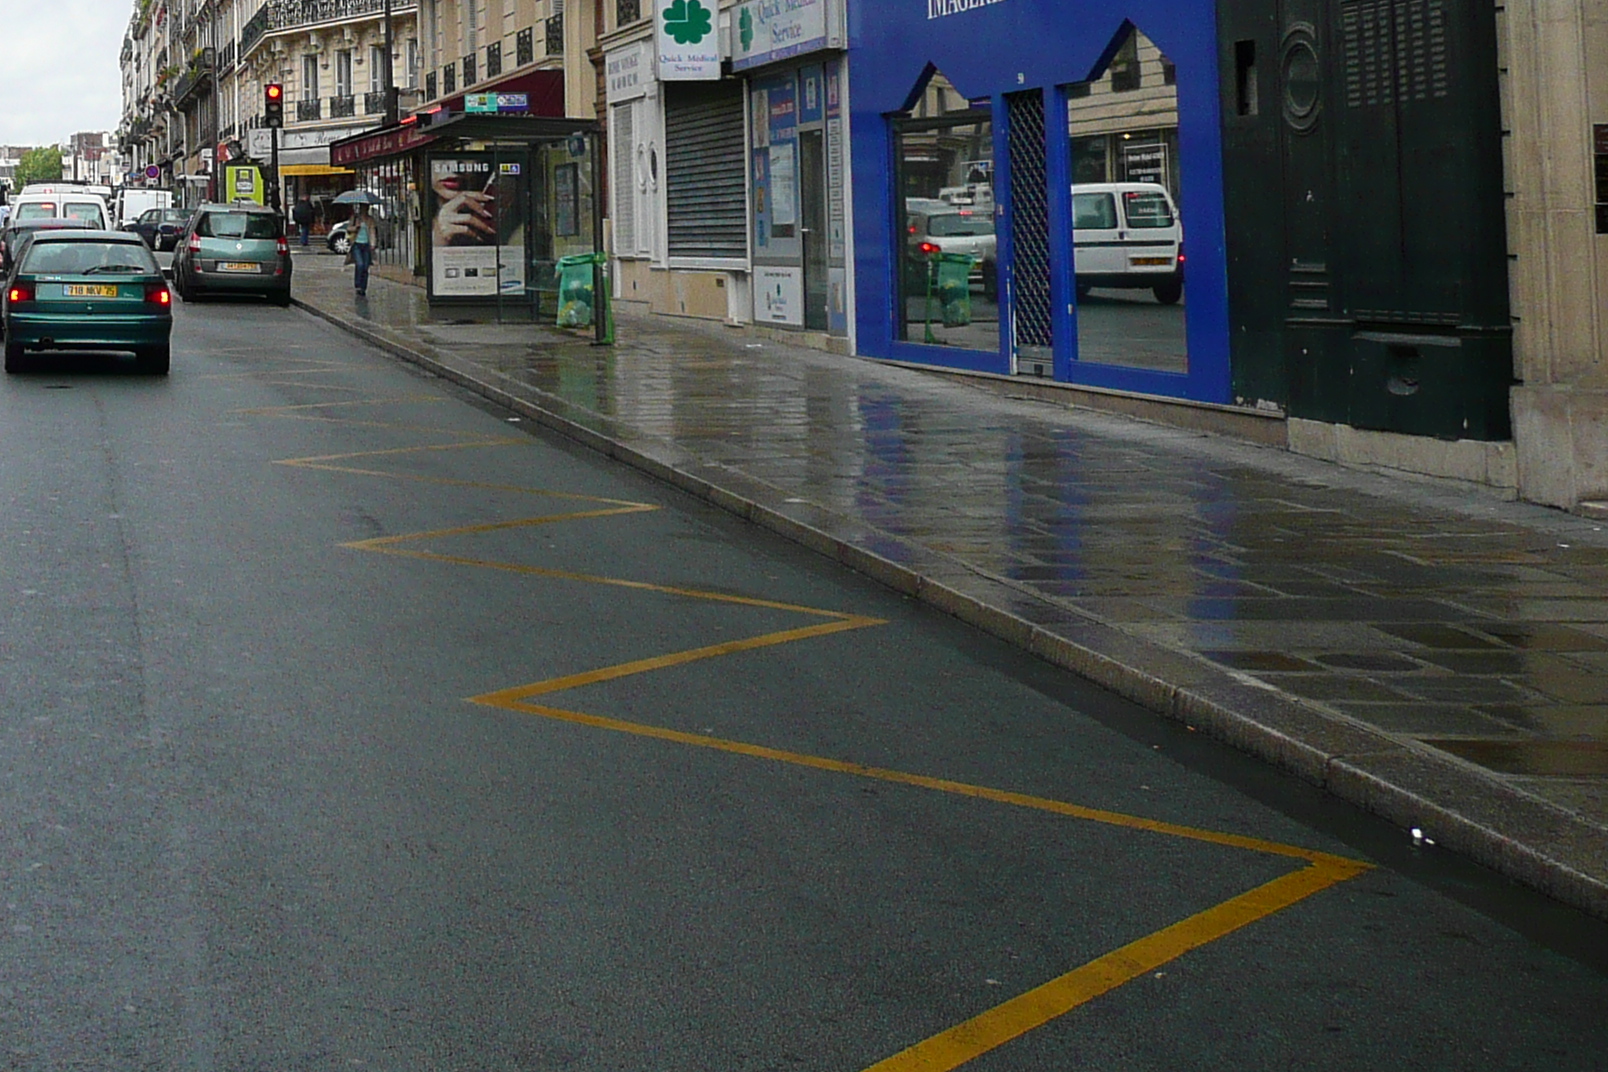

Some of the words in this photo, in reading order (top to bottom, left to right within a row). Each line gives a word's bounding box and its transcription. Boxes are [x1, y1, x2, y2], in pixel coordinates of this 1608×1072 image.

[772, 19, 802, 43] Service
[659, 54, 683, 64] Quick
[674, 64, 702, 72] Service
[434, 163, 490, 173] SAMSUNG
